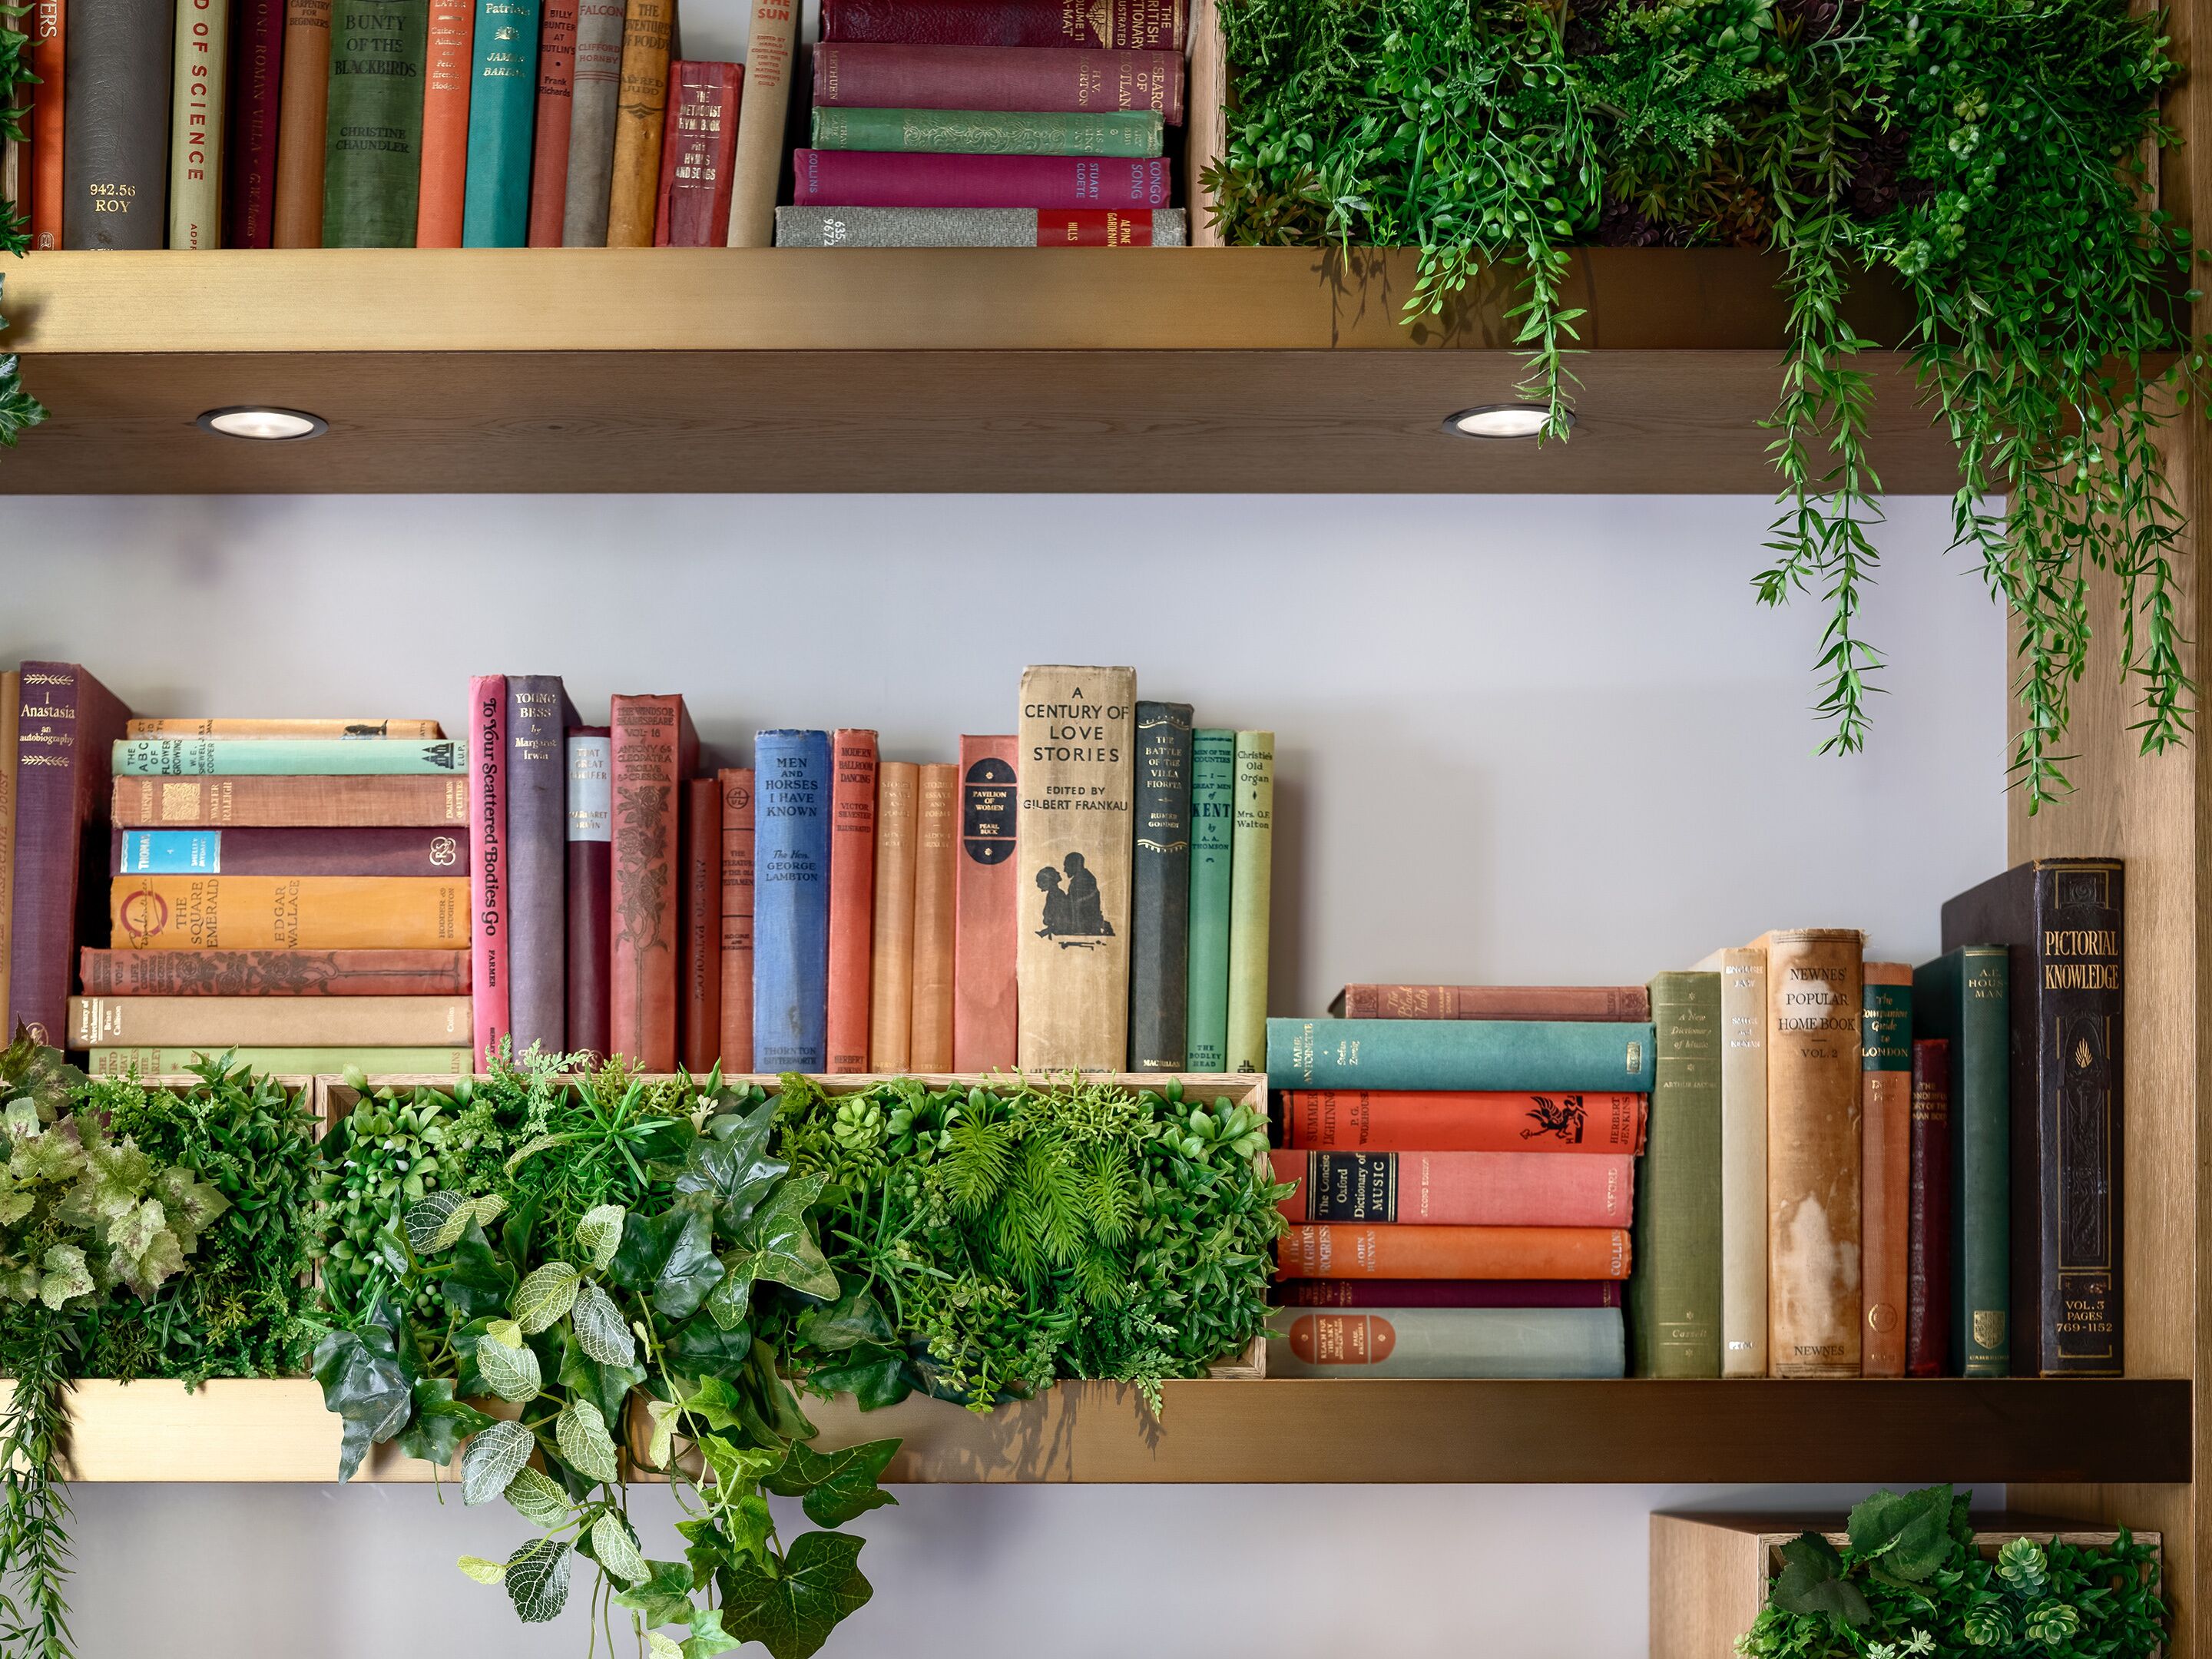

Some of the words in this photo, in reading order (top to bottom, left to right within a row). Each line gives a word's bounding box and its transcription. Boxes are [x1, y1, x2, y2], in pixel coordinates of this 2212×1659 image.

[549, 9, 573, 19] BILLY
[579, 5, 624, 17] FALCON
[638, 3, 660, 18] THE
[757, 8, 790, 22] SUN
[1161, 5, 1172, 29] THE
[345, 15, 407, 31] BUNTY
[544, 21, 576, 31] BUNTER
[193, 22, 209, 53] OF
[346, 38, 369, 52] OF
[371, 38, 404, 53] THE
[542, 44, 576, 55] BUTLIN'S
[578, 43, 621, 54] CLIFFORD
[579, 55, 618, 65] HORNBY
[253, 45, 267, 100] ROMAN
[334, 59, 418, 78] BLACKBIRDS
[829, 50, 839, 101] METHUEN
[1078, 56, 1090, 107] MORTON
[1137, 72, 1147, 92] OF
[539, 86, 571, 98] Richards
[187, 65, 208, 180] SCIENCE
[339, 126, 406, 140] CHRISTINE
[335, 140, 410, 154] CHAUNDLER
[810, 153, 818, 194] COLLINS
[1076, 163, 1086, 198] CLOETE
[1089, 163, 1098, 200] STUART
[1131, 164, 1144, 200] SONG
[1149, 161, 1161, 204] CONGO
[90, 184, 136, 197] 942.56
[94, 199, 131, 214] ROY
[823, 218, 834, 247] 9672
[1068, 222, 1078, 241] HILLS
[1120, 219, 1131, 244] ALPINE
[515, 693, 557, 704] YOUNG
[1071, 687, 1084, 699] A
[21, 704, 75, 719] Anastasia
[482, 697, 497, 718] To
[520, 707, 551, 718] BESS
[636, 707, 675, 717] WINDSOR
[1025, 704, 1103, 720] CENTURY
[1107, 706, 1129, 720] OF
[531, 724, 541, 735] by
[617, 717, 674, 727] SHAKESPEARE
[19, 733, 75, 747] autobiography
[483, 719, 499, 762] Your
[1049, 726, 1104, 740] LOVE
[515, 737, 557, 750] Margaret
[151, 750, 159, 765] OF
[161, 740, 171, 775] FLOWER
[173, 739, 183, 775] GROWING
[523, 750, 548, 760] Irwin
[618, 754, 672, 763] CLEOPATRA
[841, 747, 872, 757] MODERN
[1033, 747, 1119, 763] STORIES
[1145, 747, 1182, 756] BATTLE
[1237, 751, 1273, 761] Christie's
[777, 757, 807, 768] MEN
[839, 761, 873, 771] BALLROOM
[628, 773, 671, 782] CRESSIDA
[840, 773, 871, 783] DANCING
[1151, 770, 1179, 778] VILLA
[1240, 773, 1270, 786] Organ
[765, 780, 819, 790] HORSES
[1046, 786, 1086, 795] EDITED
[1091, 786, 1105, 795] BY
[210, 783, 220, 820] WALTER
[222, 781, 233, 821] RALEIGH
[482, 762, 498, 845] Scattered
[780, 793, 814, 803] HAVE
[1208, 792, 1217, 800] of
[767, 806, 818, 817] KNOWN
[840, 803, 869, 811] VICTOR
[1023, 800, 1071, 810] GILBERT
[1075, 800, 1128, 811] FRANKAU
[1192, 803, 1231, 818] KENT
[569, 811, 608, 820] MARGARET
[838, 811, 872, 820] SILVESTER
[1207, 823, 1217, 833] by
[1237, 820, 1269, 830] Walton
[773, 849, 788, 859] The
[767, 862, 816, 871] GEORGE
[484, 846, 499, 909] Bodies
[766, 873, 818, 882] LAMBTON
[176, 897, 187, 929] THE
[190, 881, 204, 945] SQUARE
[207, 878, 220, 949] EMERALD
[274, 885, 286, 942] EDGAR
[288, 879, 300, 949] WALLACE
[482, 910, 499, 936] Go
[2045, 930, 2119, 956] PICTORIAL
[694, 924, 706, 1002] PATHOLOGY
[131, 963, 139, 983] LIFE
[1790, 967, 1846, 981] NEWNES'
[2045, 964, 2120, 990] KNOWLEDGE
[1786, 993, 1849, 1005] POPULAR
[1975, 989, 2004, 998] MAN
[1398, 985, 1412, 1018] Black
[1414, 988, 1429, 1017] Tulip
[1862, 1008, 1908, 1018] Companion
[1778, 1018, 1817, 1031] HOME
[1820, 1018, 1856, 1031] BOOK
[763, 1047, 816, 1056] THORNTON
[1293, 1036, 1303, 1068] MARIE
[1336, 1040, 1346, 1066] Stefan
[1349, 1040, 1360, 1066] Zweig
[1801, 1049, 1830, 1058] VOL.
[1862, 1046, 1909, 1057] LONDON
[763, 1057, 816, 1065] BUTTERWORTH
[834, 1055, 864, 1064] HERBERT
[1306, 1091, 1319, 1142] SUMMER
[1323, 1091, 1336, 1146] LIGHTNING
[1359, 1091, 1369, 1145] WODEHOUSE
[1610, 1097, 1620, 1144] HERBERT
[1620, 1096, 1630, 1144] JENKINS
[1358, 1153, 1366, 1164] of
[1320, 1154, 1330, 1193] Concise
[1336, 1168, 1348, 1204] Oxford
[1354, 1164, 1369, 1218] Dictionary
[1373, 1161, 1384, 1211] MUSIC
[1608, 1167, 1618, 1216] OXFORD
[1319, 1194, 1330, 1216] The
[1303, 1225, 1314, 1276] PILGRIM'S
[1319, 1225, 1330, 1276] PROGRESS
[2065, 1300, 2094, 1310] VOL.
[2097, 1300, 2104, 1310] 3
[2067, 1312, 2103, 1321] PAGES
[2056, 1323, 2113, 1333] 769-1152
[1794, 1345, 1844, 1356] NEWNES
